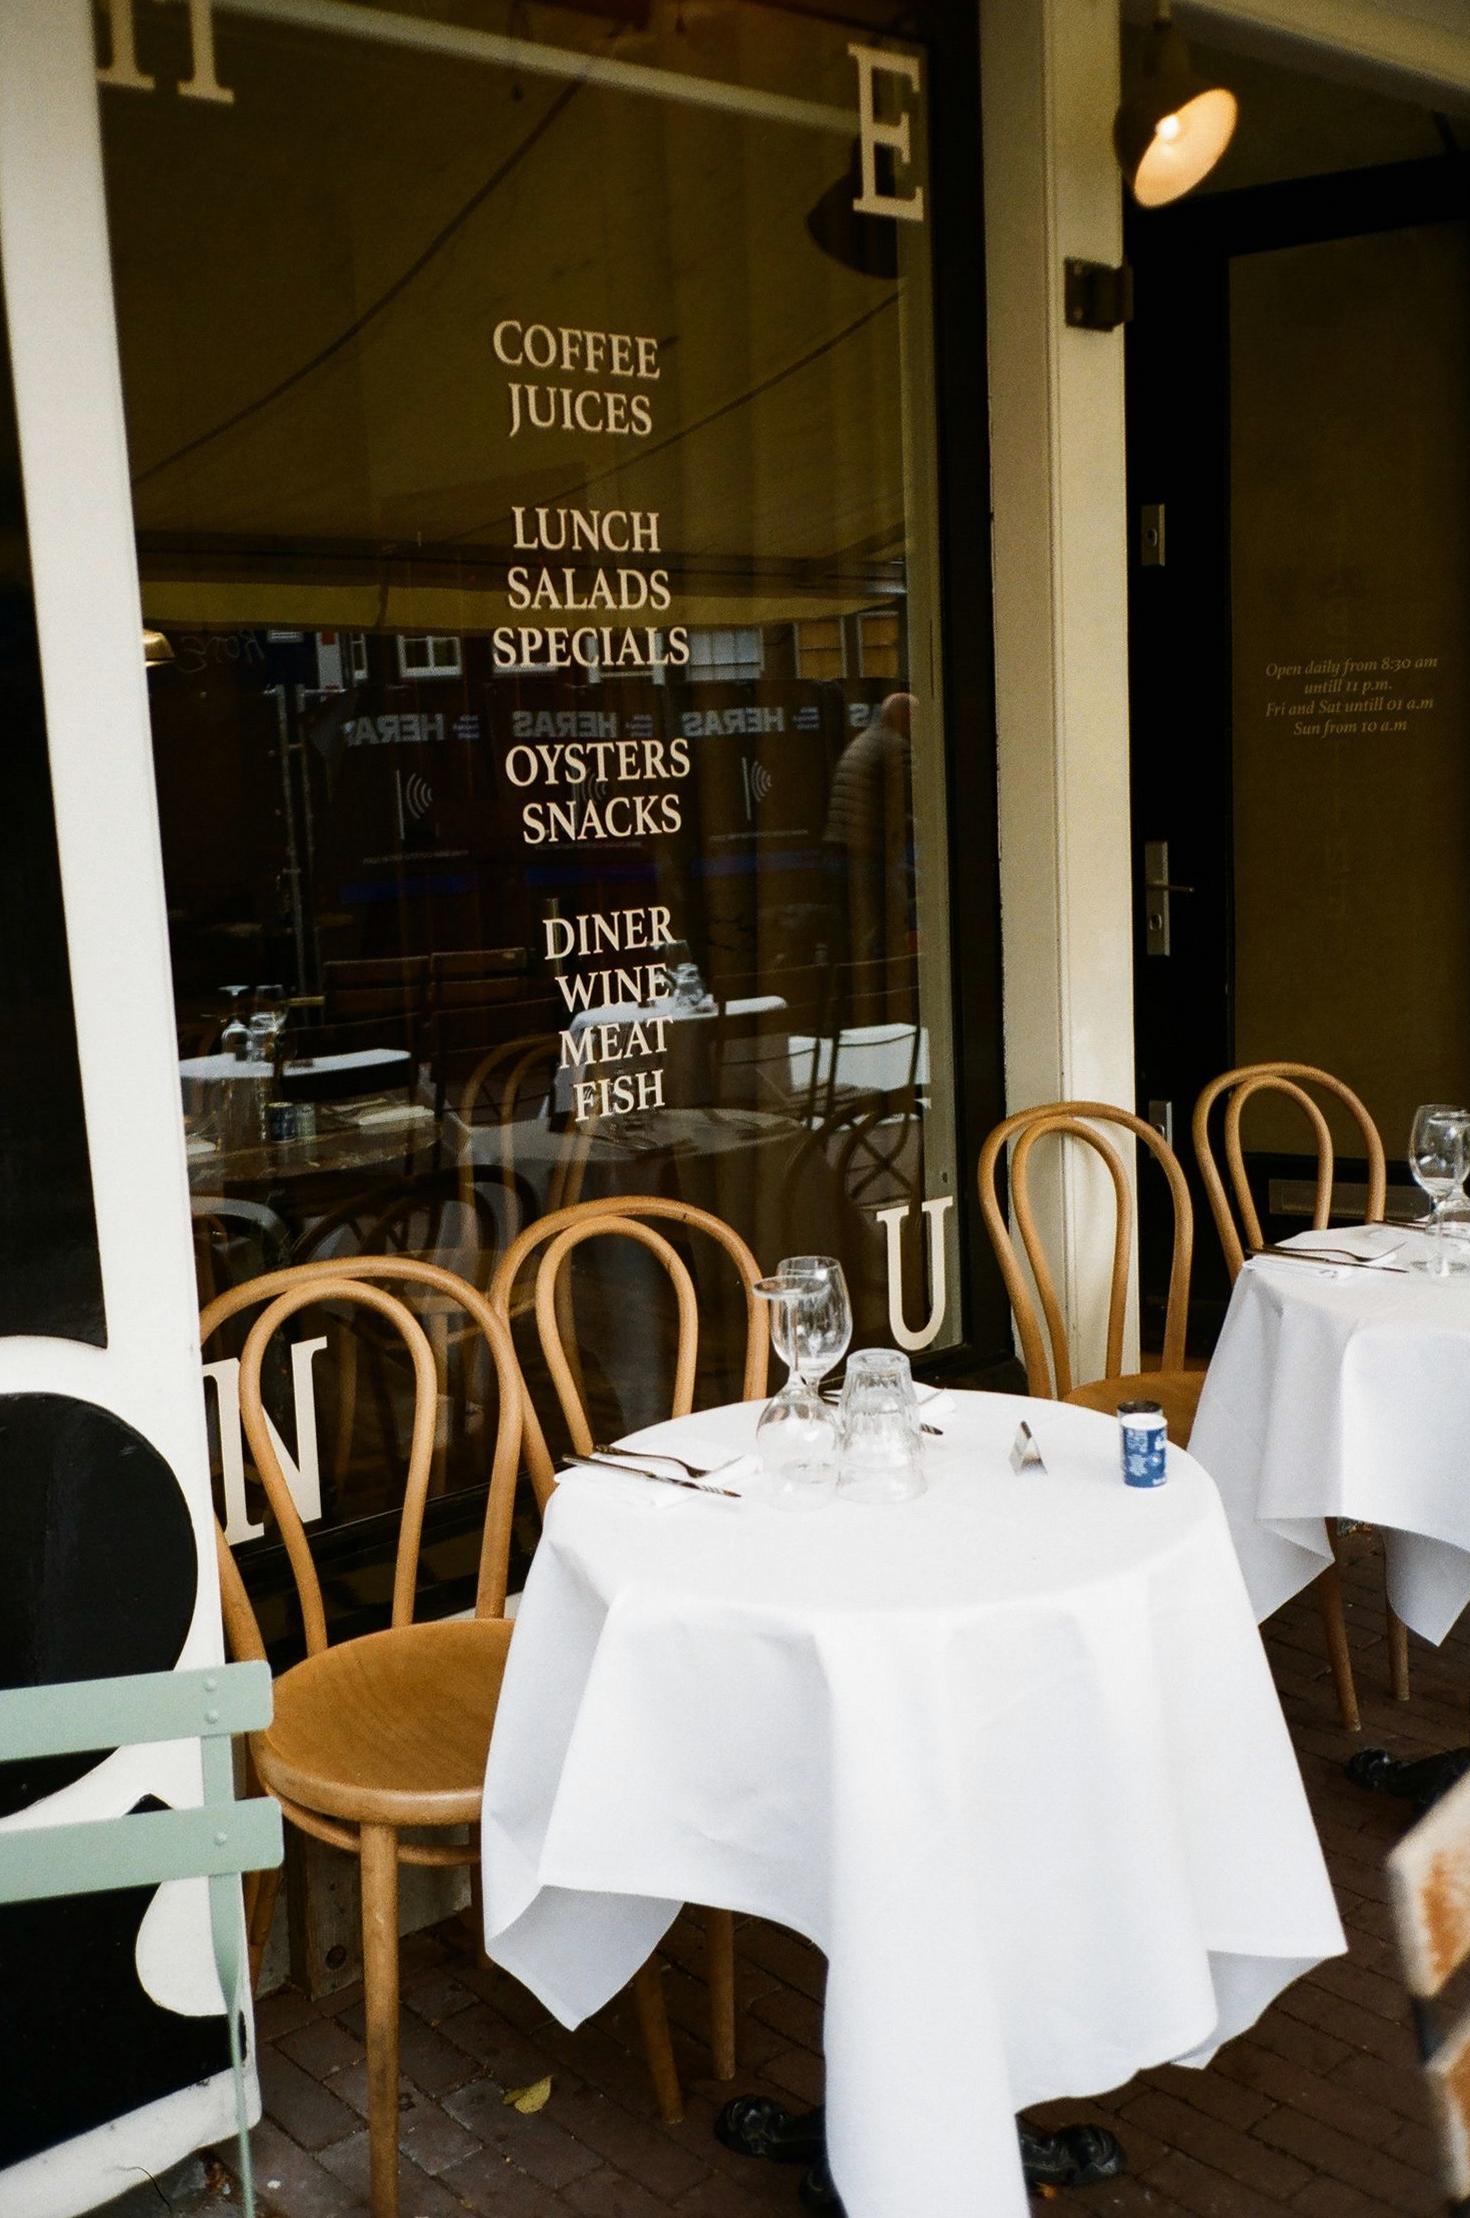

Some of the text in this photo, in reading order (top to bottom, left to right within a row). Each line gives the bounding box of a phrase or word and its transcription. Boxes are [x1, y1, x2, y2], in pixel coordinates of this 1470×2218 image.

[848, 43, 924, 222] E
[493, 320, 661, 380] COFFEE
[508, 383, 653, 437] JUICES
[511, 506, 661, 553] LUNCH
[507, 566, 671, 611] SALADS
[493, 626, 690, 669] SPECIALS
[1265, 657, 1438, 680] Open daily from 8:30 am
[1265, 696, 1435, 718] Fri and Sat untill 01 a.m
[1304, 678, 1393, 695] untill 11 p.m.
[1293, 719, 1408, 740] Sun from 10 a.m
[505, 738, 690, 787] OYSTERS
[522, 794, 682, 844] SNACKS
[543, 906, 676, 960] DINER
[556, 963, 673, 1013] WINE
[559, 1015, 673, 1069] MEAT
[573, 1070, 665, 1122] FISH
[877, 1196, 953, 1351] U
[202, 1336, 328, 1546] N
